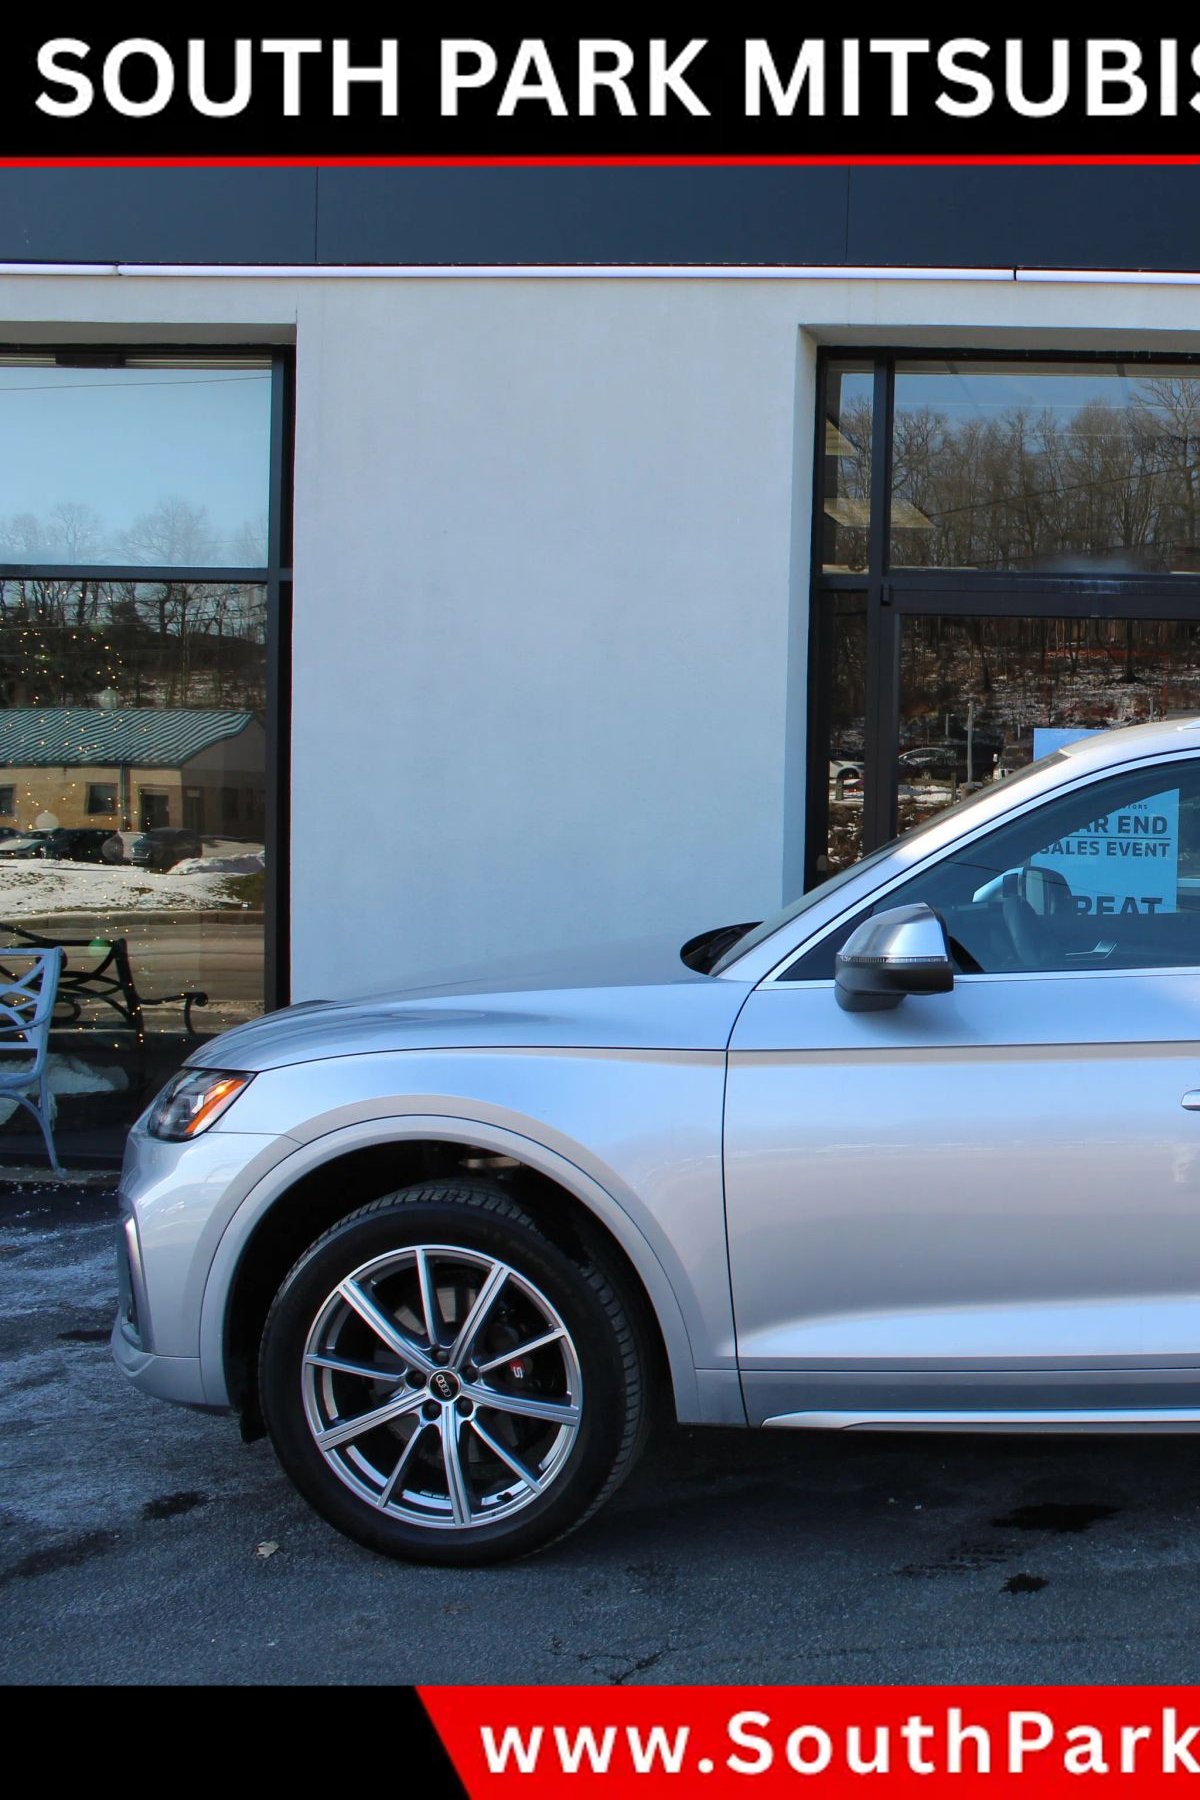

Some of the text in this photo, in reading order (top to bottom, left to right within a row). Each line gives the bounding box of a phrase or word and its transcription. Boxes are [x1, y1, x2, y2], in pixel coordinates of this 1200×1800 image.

[1117, 815, 1168, 834] END
[1106, 842, 1170, 857] EVENT
[1072, 895, 1163, 915] REAT
